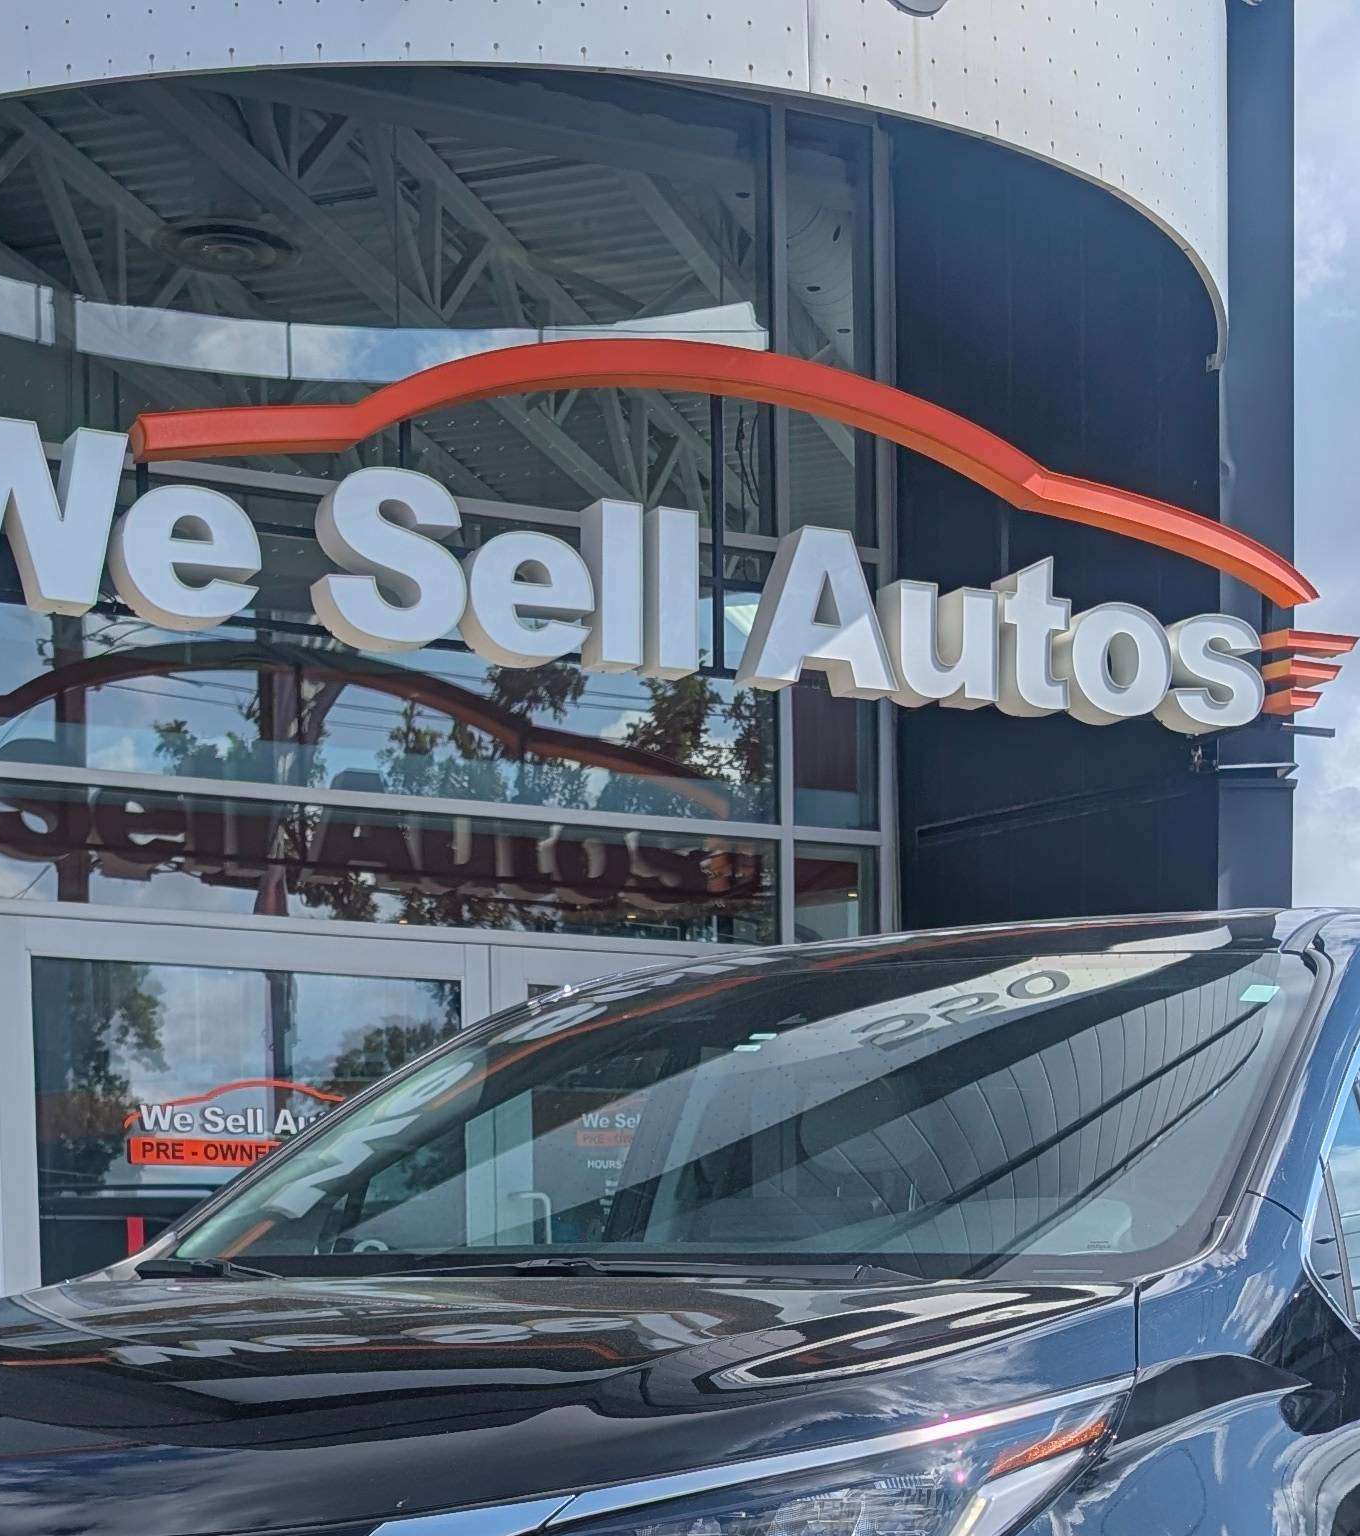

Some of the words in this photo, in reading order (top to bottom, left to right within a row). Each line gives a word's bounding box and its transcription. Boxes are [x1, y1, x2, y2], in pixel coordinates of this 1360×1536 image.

[310, 466, 699, 681] Sell
[733, 525, 1266, 736] Autos
[139, 1103, 194, 1132] We
[203, 1106, 264, 1134] Sell
[581, 1112, 611, 1129] We
[614, 1112, 641, 1129] Sel
[140, 1141, 186, 1161] PRE
[586, 1159, 623, 1170] HOURS
